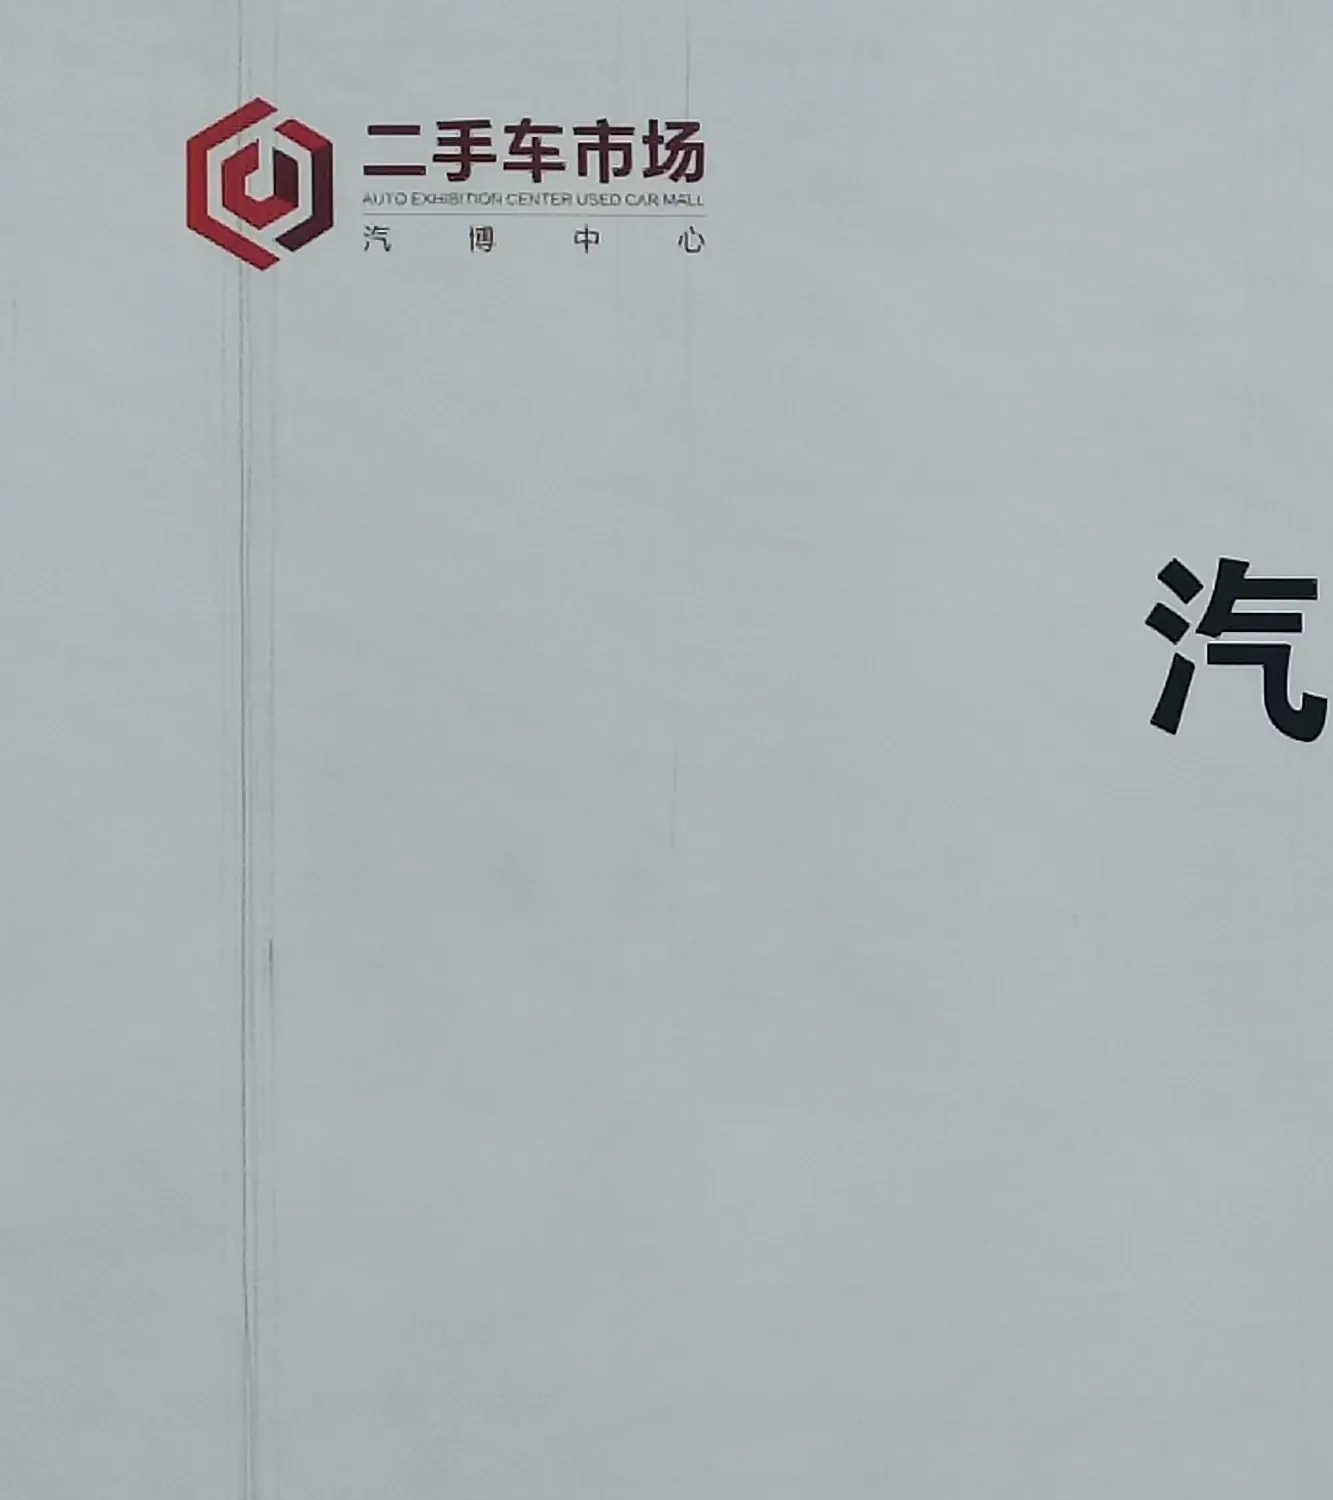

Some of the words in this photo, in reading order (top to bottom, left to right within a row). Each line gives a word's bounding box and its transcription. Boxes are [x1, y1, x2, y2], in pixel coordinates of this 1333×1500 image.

[362, 118, 706, 184] 二手车市场
[363, 191, 408, 206] AUTO
[411, 191, 502, 206] EXHIBITION
[506, 191, 573, 207] CENTER
[576, 192, 621, 207] USED
[624, 192, 659, 207] CAR
[662, 192, 705, 207] MALL
[363, 223, 706, 254] 汽博中心
